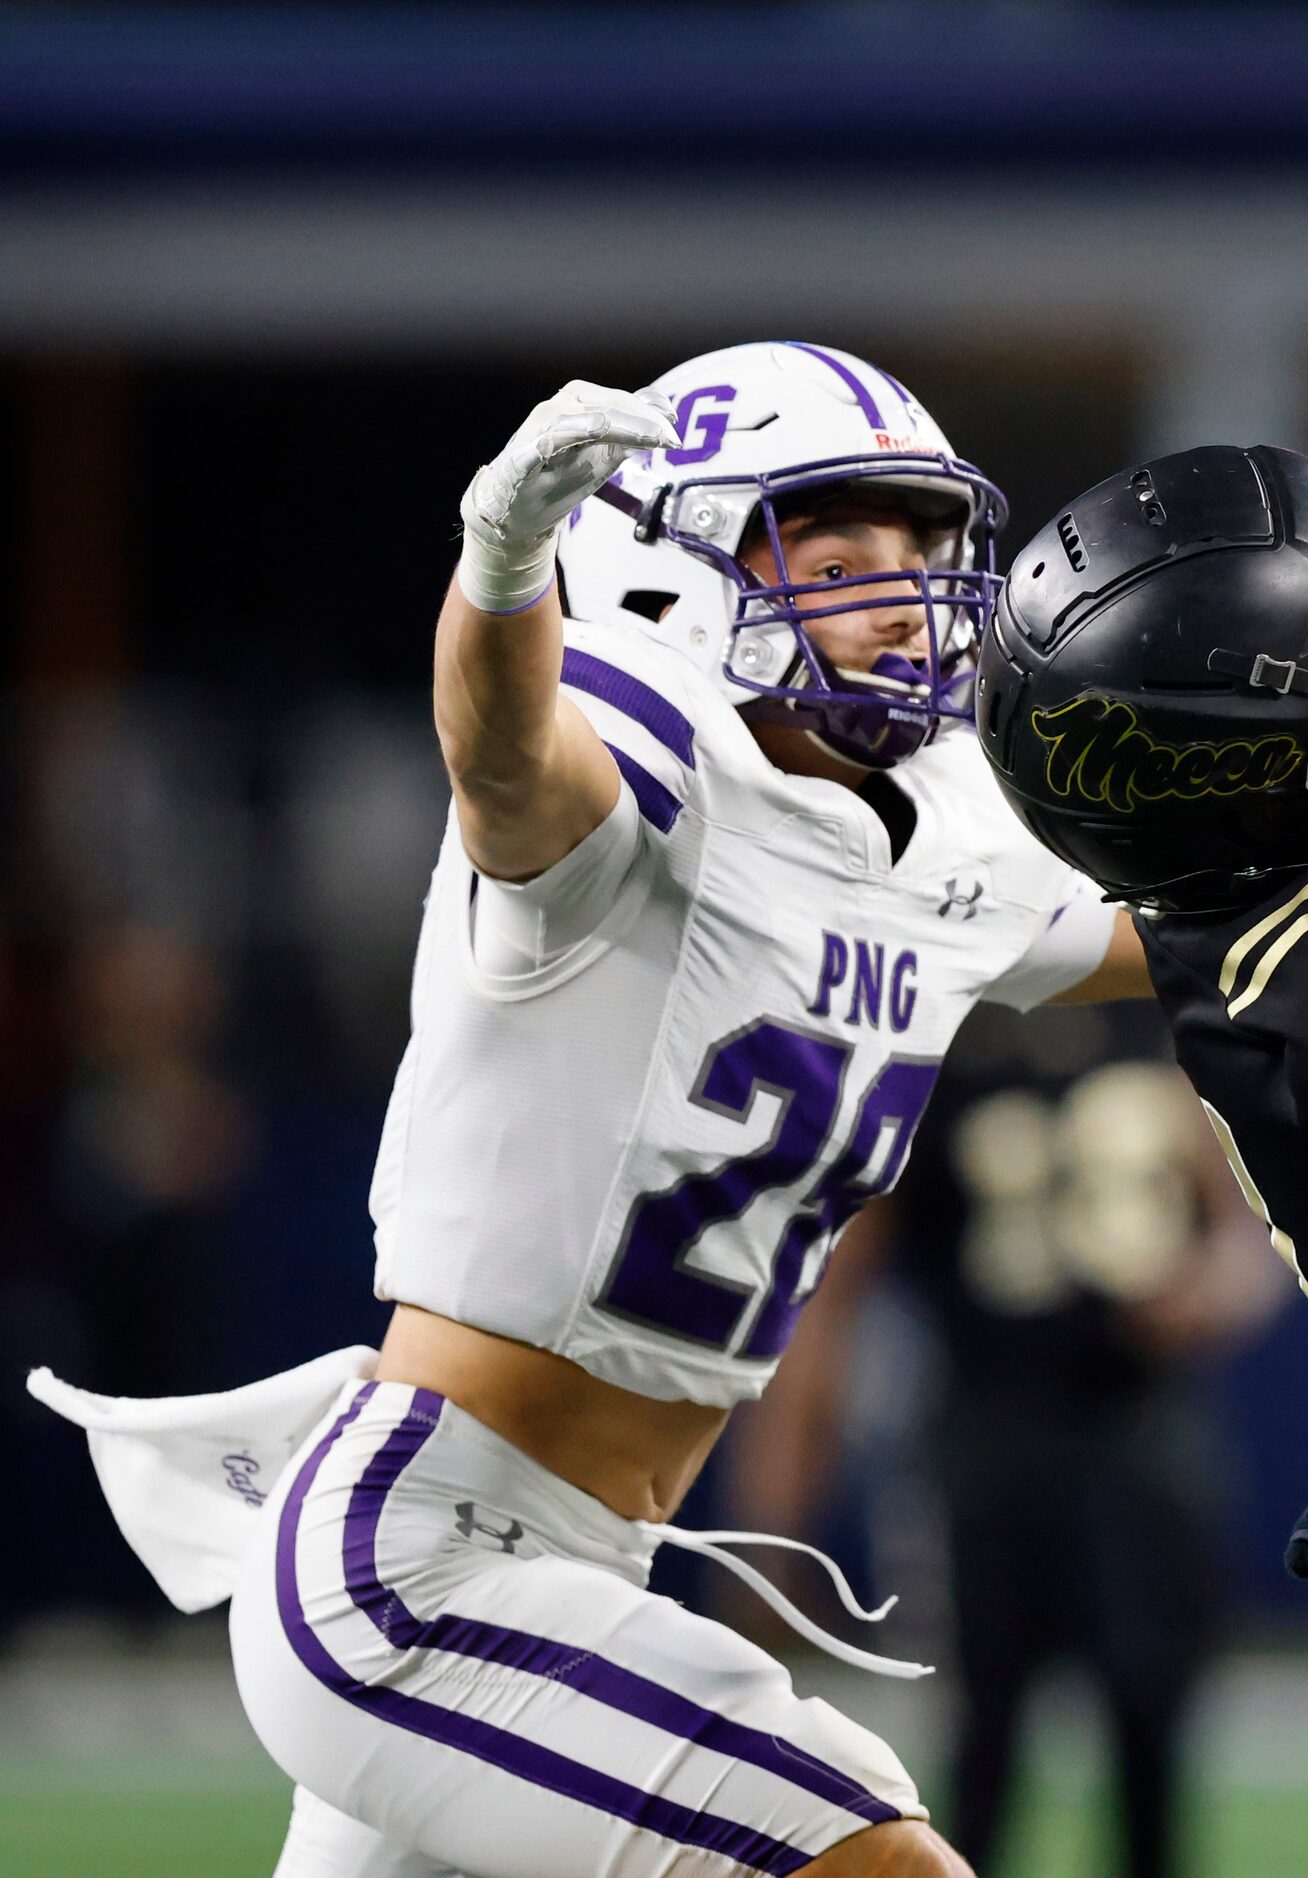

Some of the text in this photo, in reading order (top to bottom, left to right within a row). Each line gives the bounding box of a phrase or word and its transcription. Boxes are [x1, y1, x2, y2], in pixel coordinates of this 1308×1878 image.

[1031, 690, 1302, 813] Mecca
[808, 928, 918, 1033] PNG
[592, 1012, 943, 1360] 28
